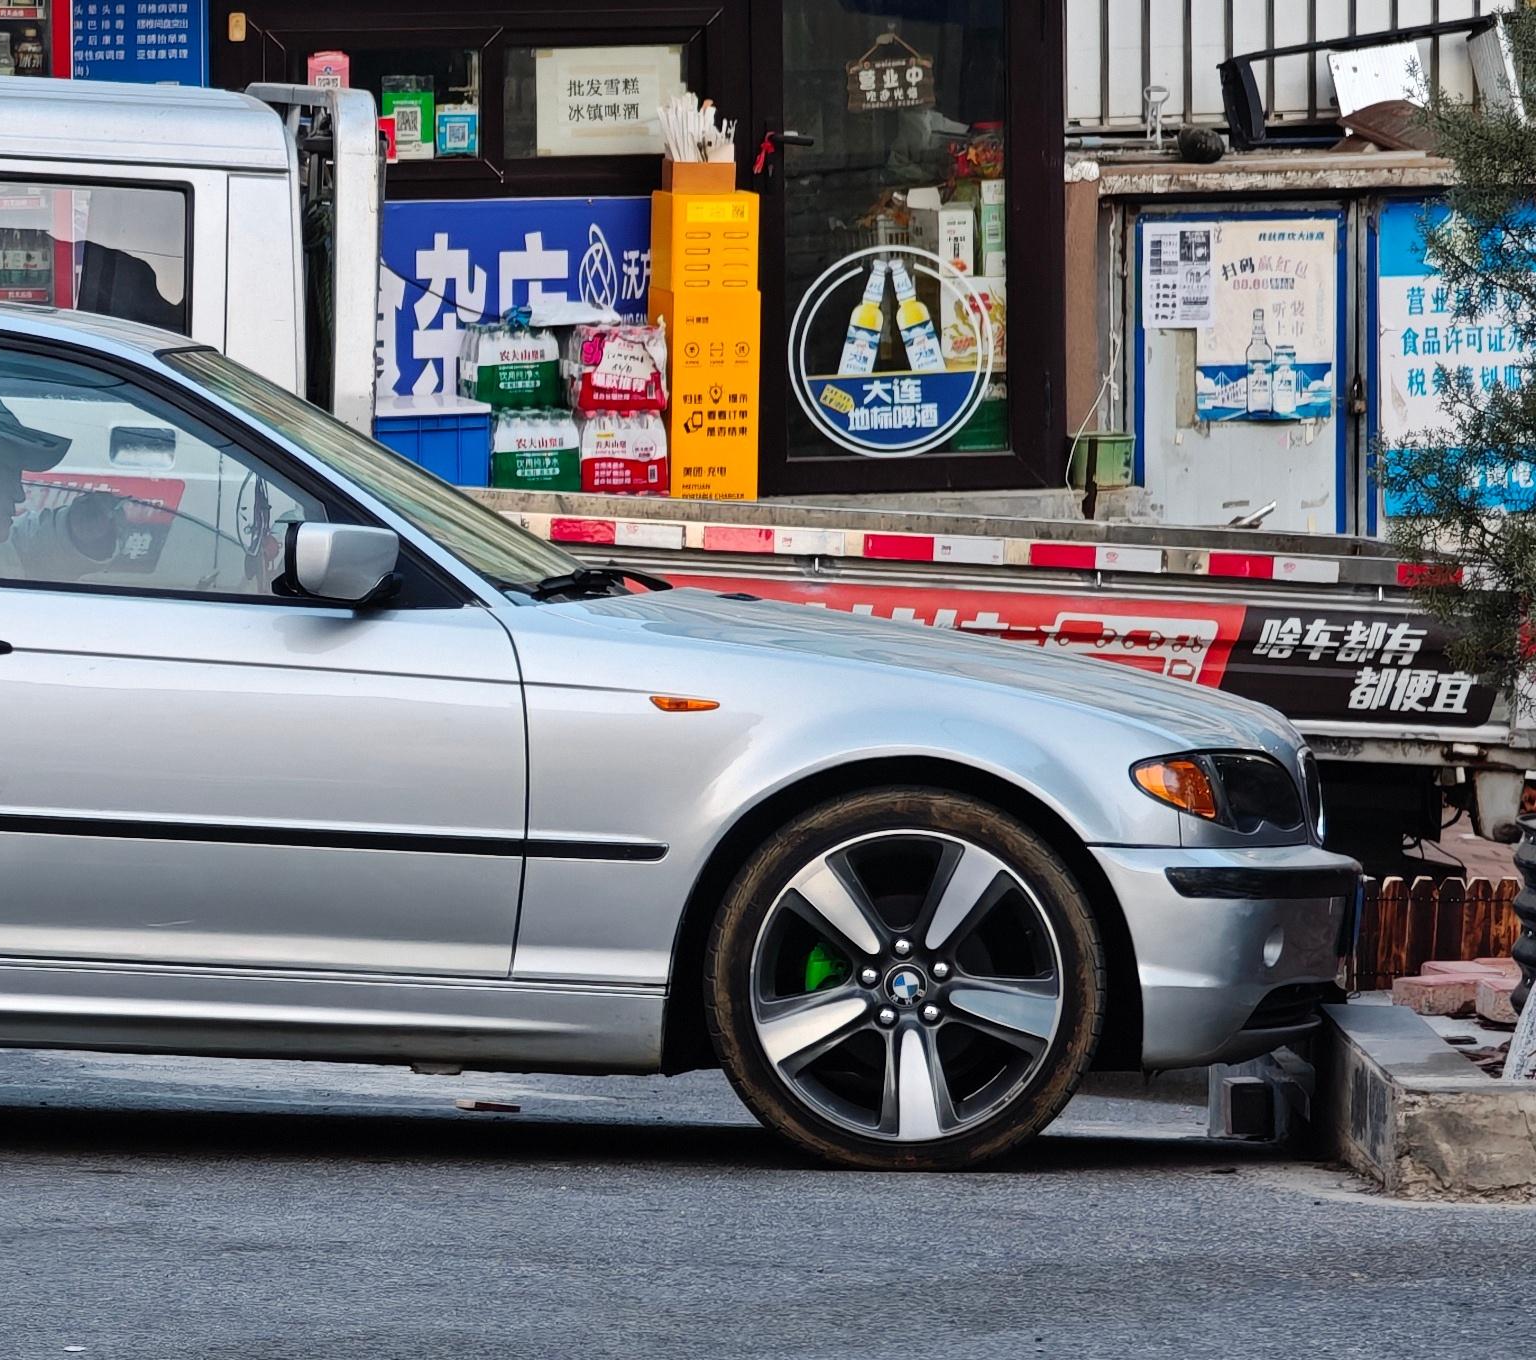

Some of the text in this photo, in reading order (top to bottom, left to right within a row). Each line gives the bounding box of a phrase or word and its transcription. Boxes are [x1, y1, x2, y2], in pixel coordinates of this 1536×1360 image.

[567, 77, 640, 97] 批发雪糕
[858, 66, 923, 90] 营业中
[568, 103, 639, 122] 冰镇啤酒
[1401, 325, 1536, 357] 食品许可证办
[862, 378, 922, 404] 大连
[707, 410, 748, 420] 看看订单
[847, 403, 938, 431] 地标啤酒
[1252, 617, 1428, 665] 啥车都有
[1348, 666, 1478, 714] 都便宜
